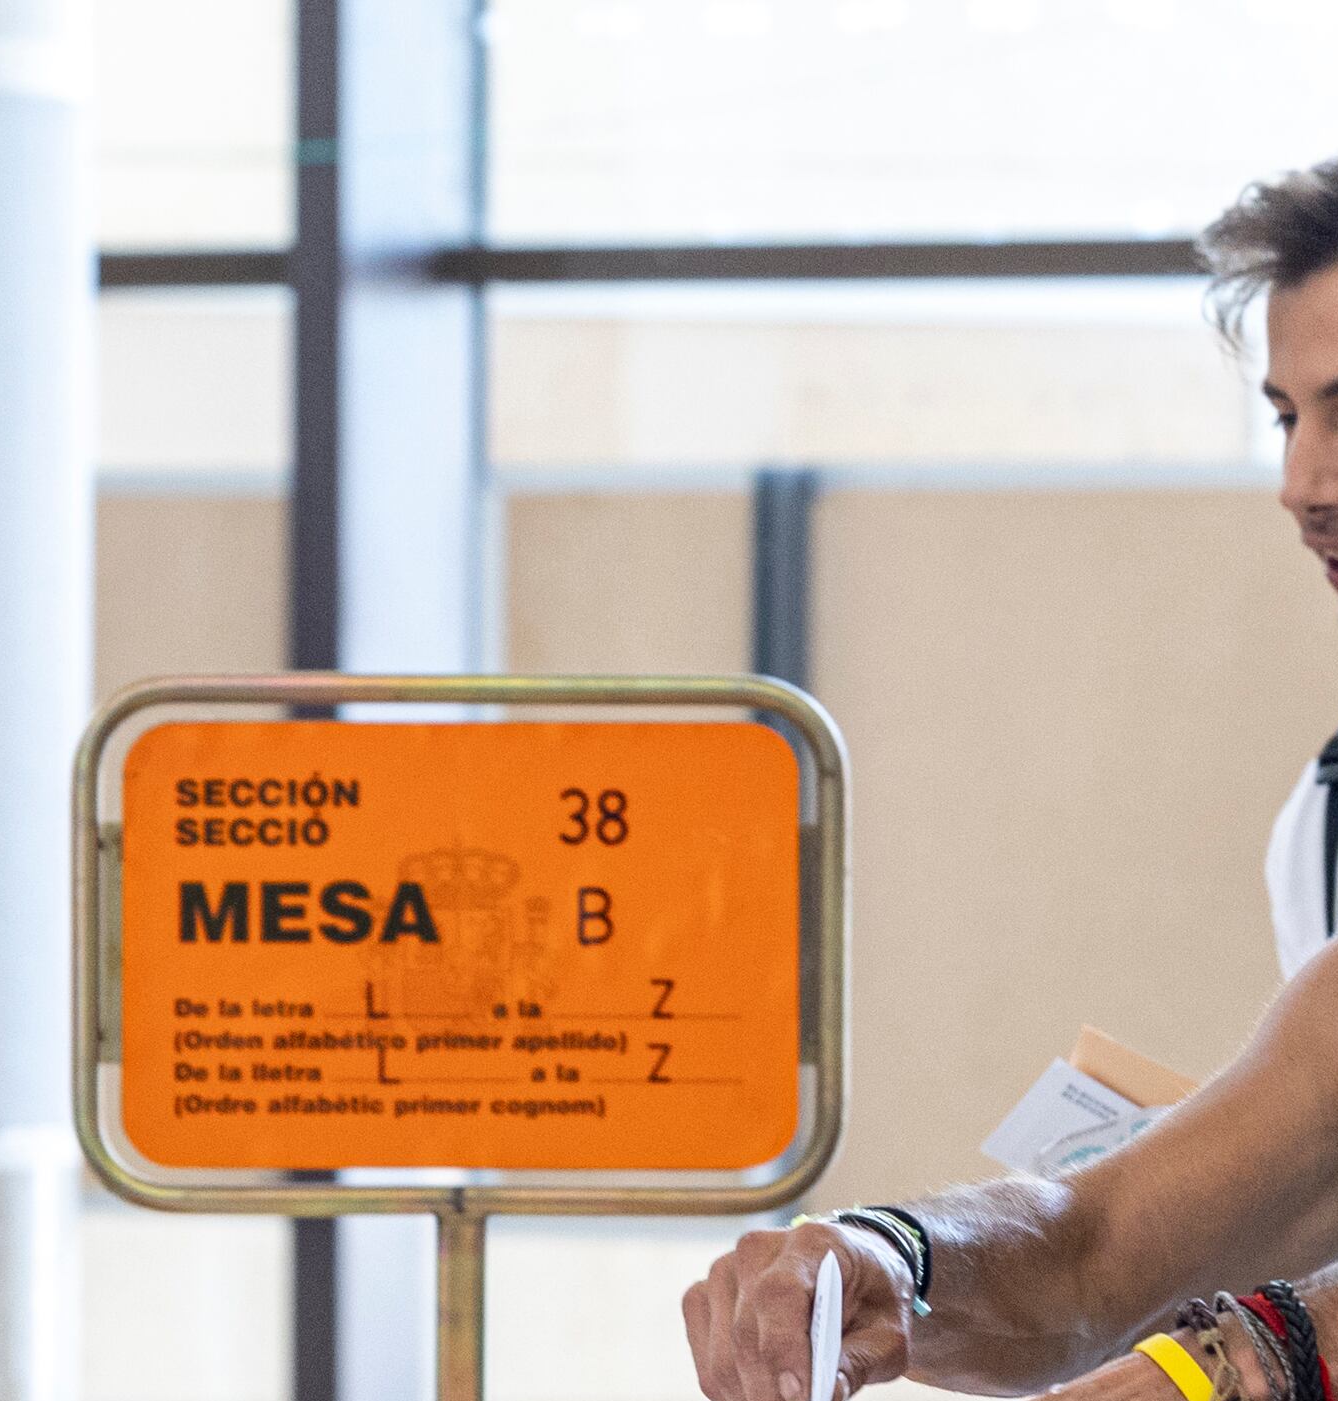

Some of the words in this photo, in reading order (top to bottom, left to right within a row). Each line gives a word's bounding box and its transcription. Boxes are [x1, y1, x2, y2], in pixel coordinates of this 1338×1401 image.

[175, 772, 360, 807] SECCIÓN
[175, 809, 330, 846] SECCIÓ
[560, 787, 629, 845] 38
[179, 880, 441, 943] MESA
[577, 886, 614, 946] B
[174, 999, 208, 1018] De
[219, 999, 242, 1018] la
[252, 999, 315, 1018] letra
[365, 980, 390, 1020] L
[492, 1002, 509, 1019] a
[518, 1000, 542, 1019] la
[649, 978, 675, 1019] Z
[416, 1030, 502, 1054] primer
[174, 1063, 208, 1082] De
[219, 1063, 242, 1082] la
[377, 1046, 402, 1085] L
[530, 1066, 547, 1082] a
[555, 1063, 580, 1083] la
[647, 1042, 674, 1083] Z
[394, 1094, 480, 1118] primer
